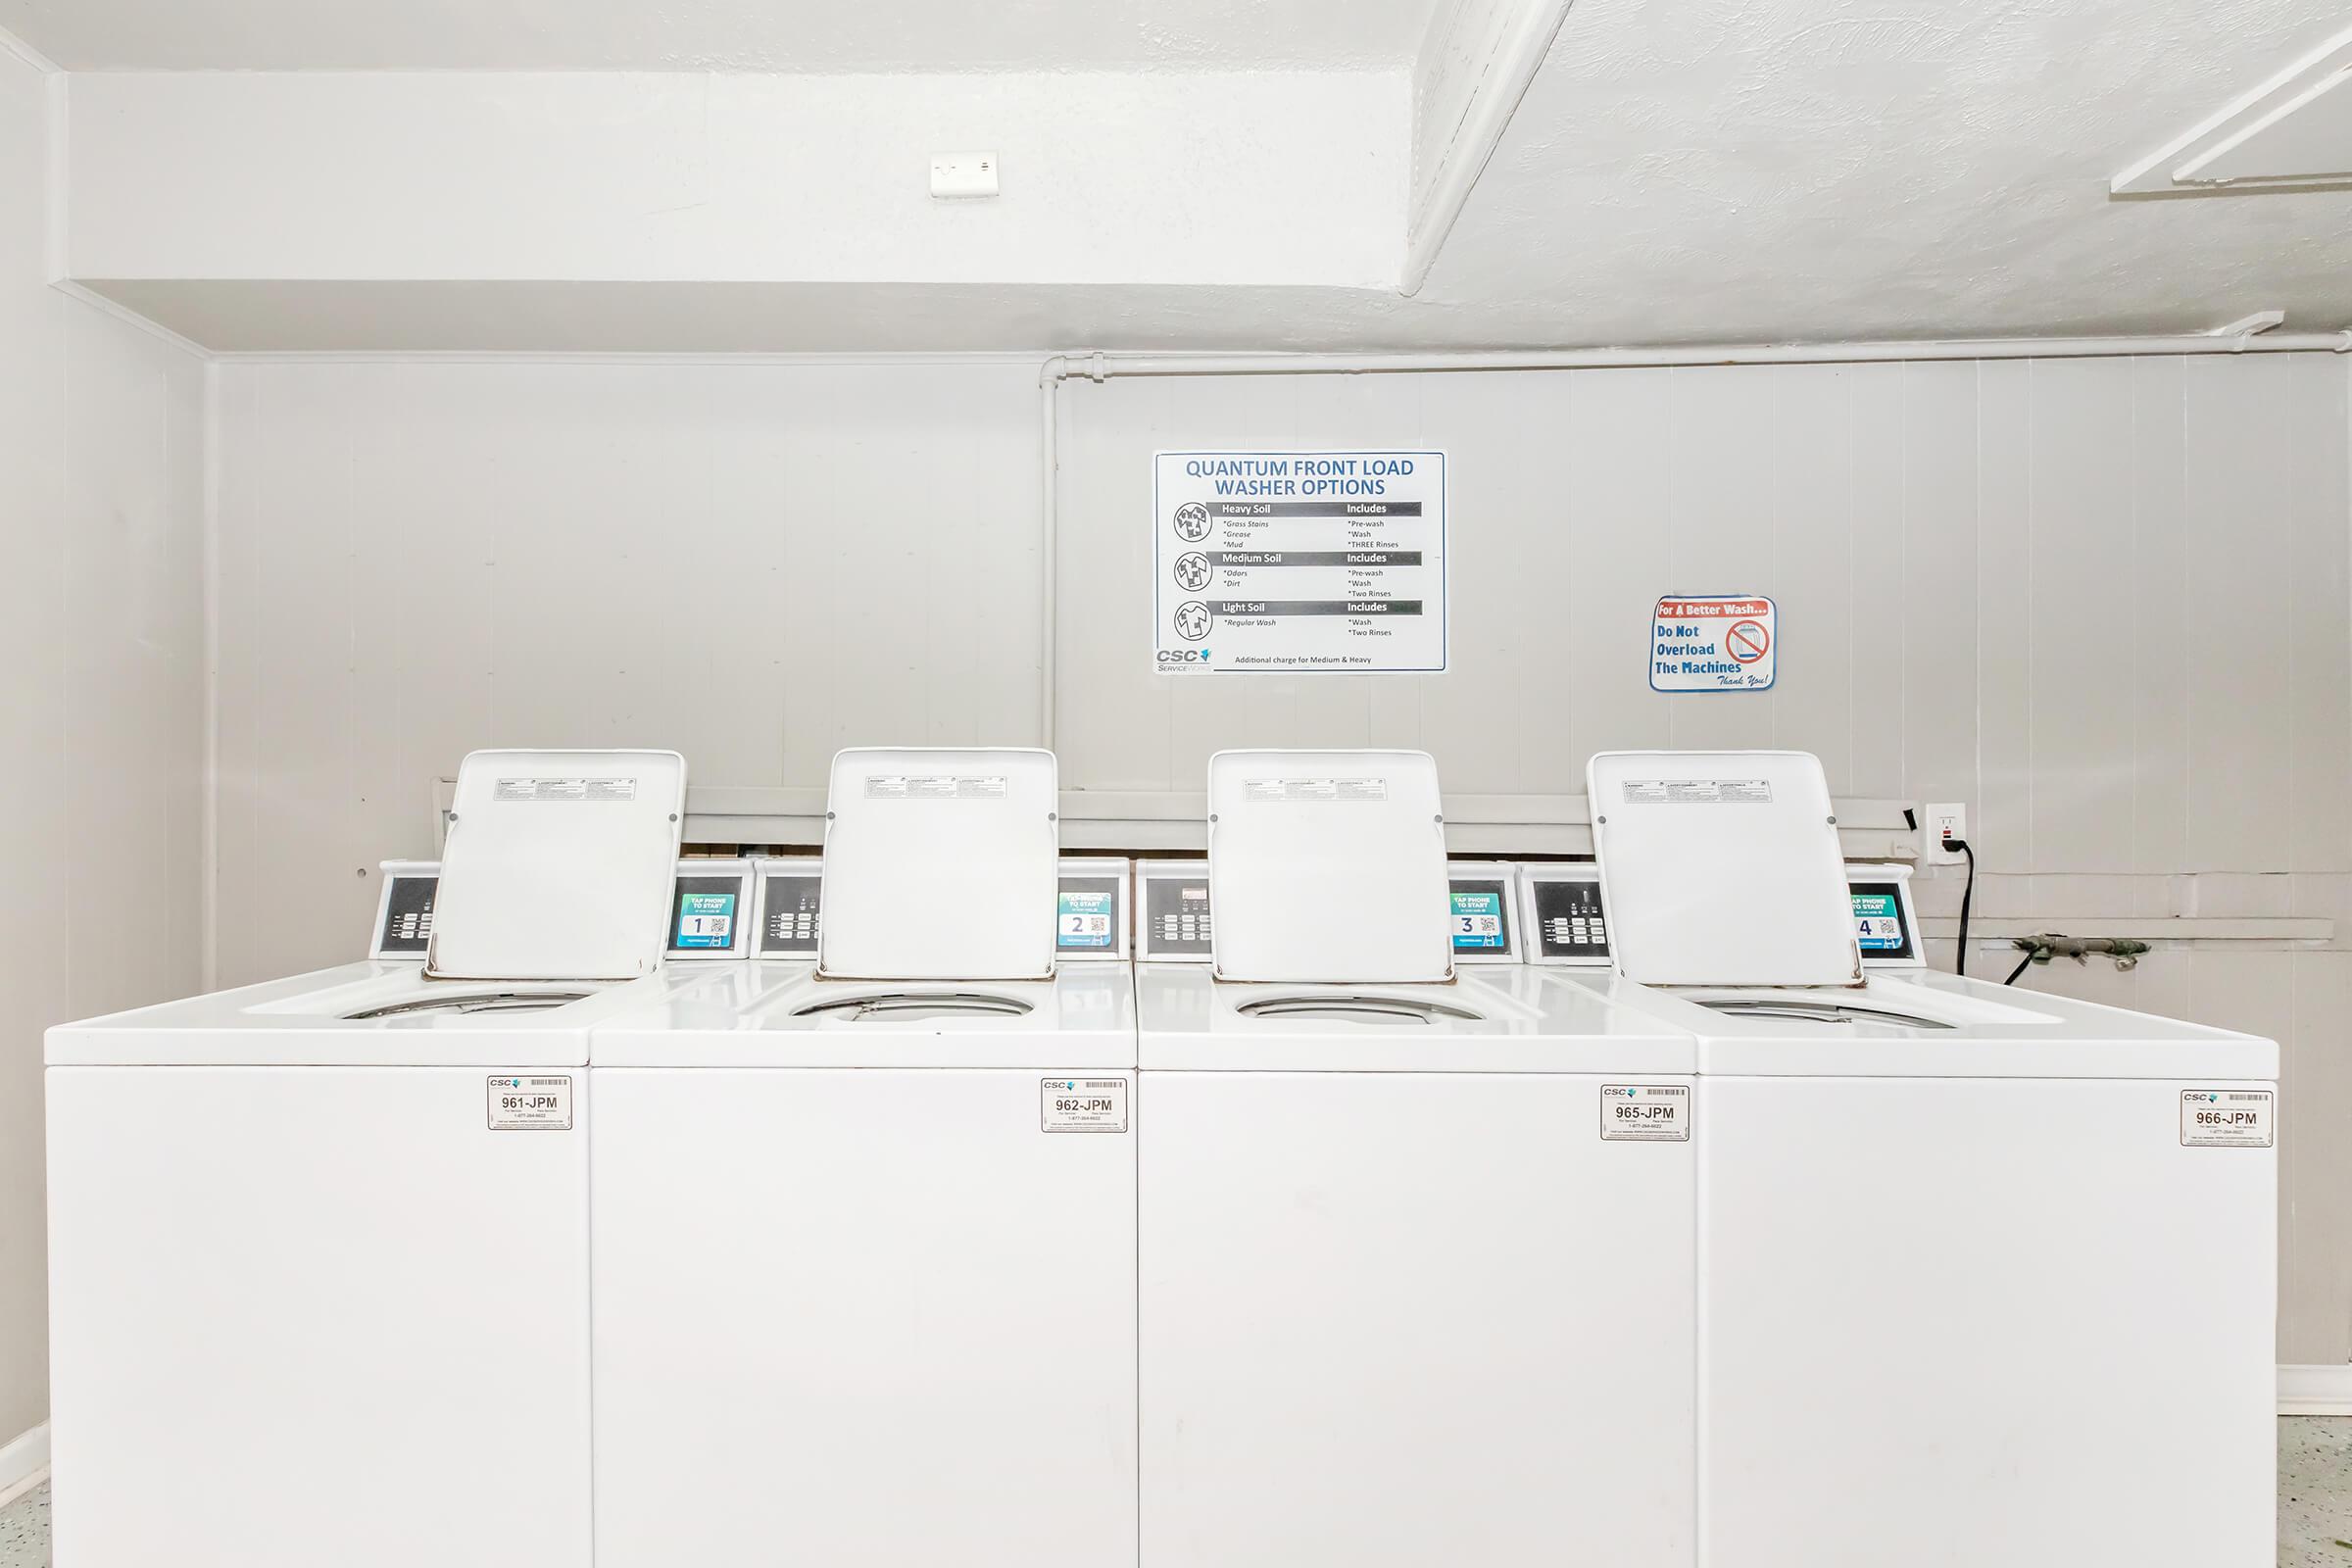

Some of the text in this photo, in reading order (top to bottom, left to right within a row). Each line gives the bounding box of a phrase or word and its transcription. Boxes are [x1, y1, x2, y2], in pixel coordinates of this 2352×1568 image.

[1186, 461, 1413, 476] QUANTUM FRONT LOAD
[1215, 479, 1385, 495] WASHER OPTIONS
[1222, 505, 1270, 515] Heavy Soil
[1348, 504, 1387, 514] Includes
[1223, 554, 1282, 563] Medium Soil
[1348, 553, 1387, 563] Includes
[1223, 603, 1265, 613] Light Soil
[1348, 602, 1387, 612] Includes
[1659, 604, 1766, 615] For A Better Wash...
[1658, 625, 1699, 637] Do Not
[1657, 643, 1715, 656] Overload
[1156, 650, 1198, 662] CSC
[1272, 657, 1296, 665] charge
[1349, 657, 1371, 665] Heavy
[1656, 662, 1741, 674] The Machines
[1717, 674, 1768, 687] Thank You!
[695, 918, 702, 933] 1
[1072, 917, 1083, 932] 2
[1461, 918, 1473, 932] 3
[1860, 920, 1872, 935] 4
[502, 1098, 557, 1108] 961-JPM
[1056, 1100, 1112, 1110] 962-JPM
[1616, 1107, 1674, 1118] 965-JPM
[2196, 1113, 2256, 1124] 966-JPM
